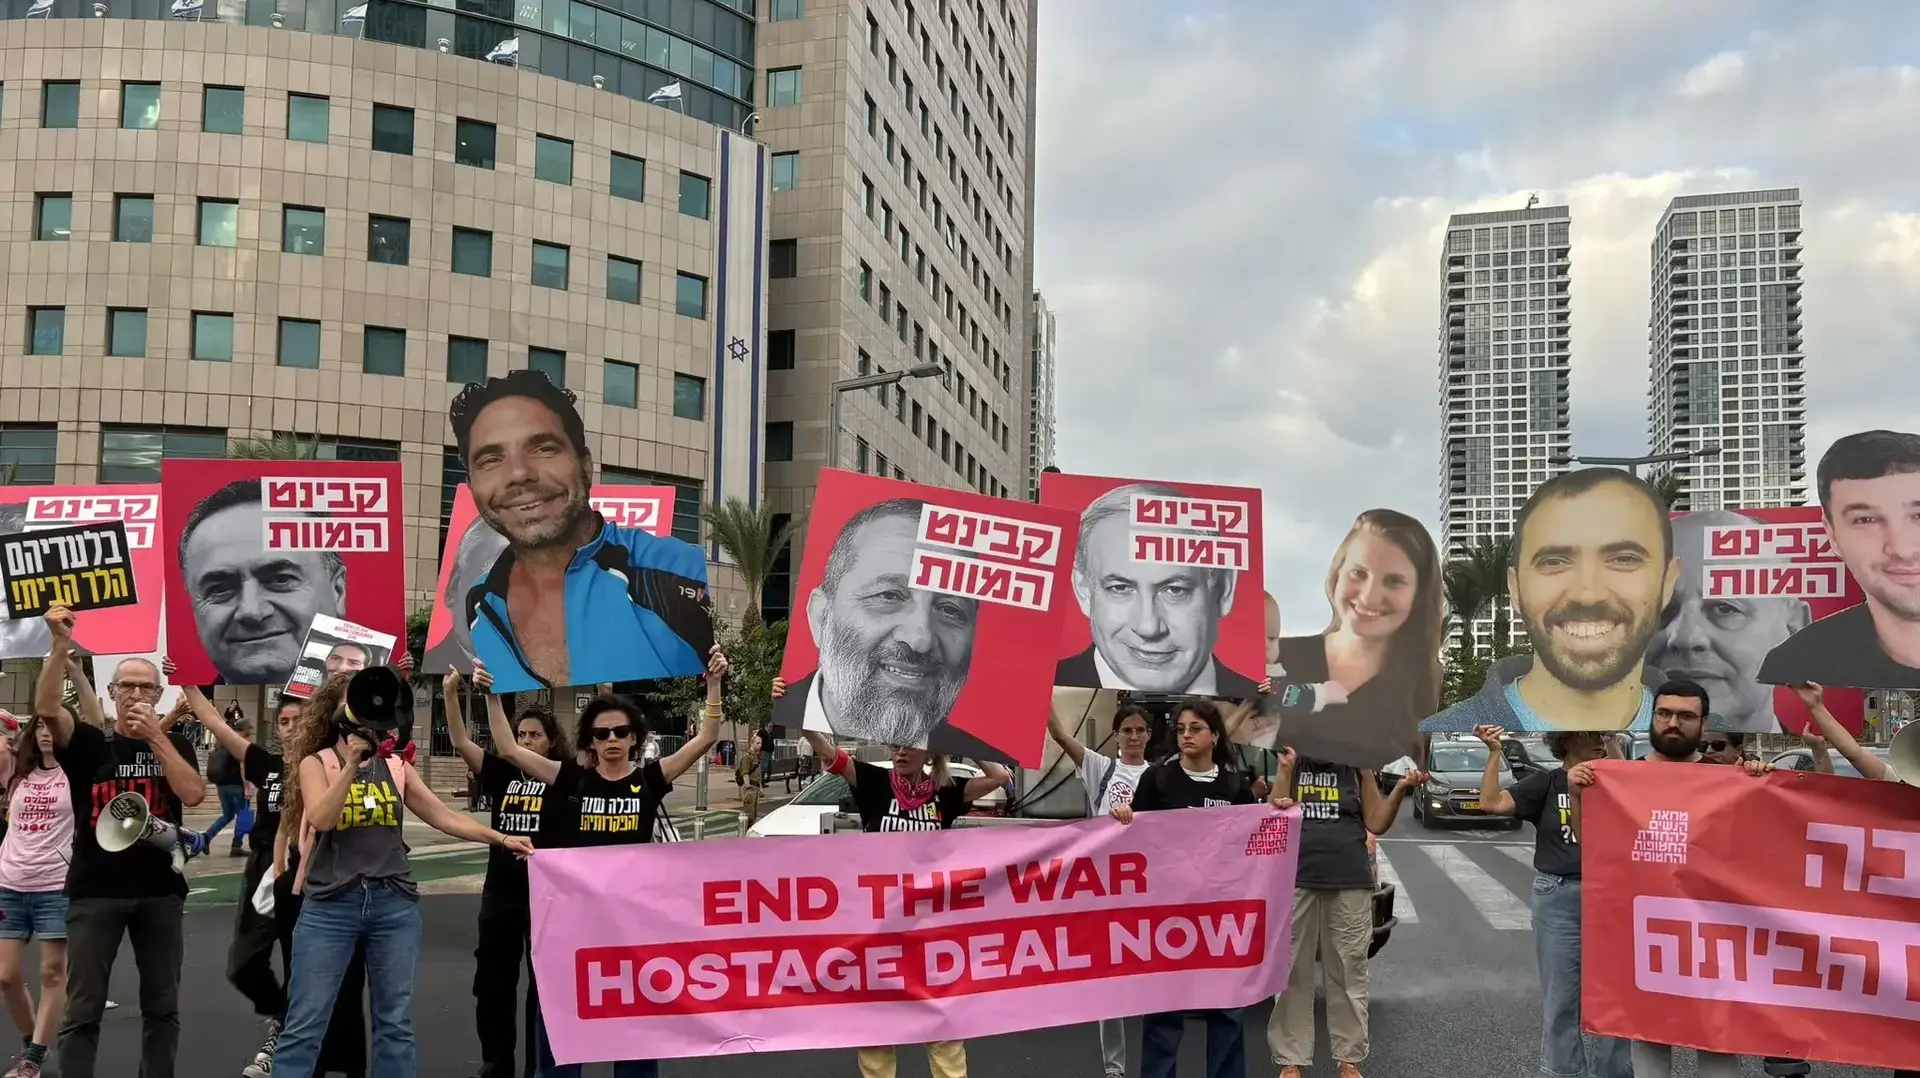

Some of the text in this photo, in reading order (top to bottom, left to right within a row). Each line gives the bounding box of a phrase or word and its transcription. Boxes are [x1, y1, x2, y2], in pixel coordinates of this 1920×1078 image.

[269, 482, 381, 512] קבינט
[34, 498, 152, 523] קבינט
[592, 502, 653, 528] קבי
[1136, 498, 1242, 536] קבינט
[268, 522, 382, 548] המוות
[926, 510, 1054, 560] קבינט
[1711, 526, 1831, 561] קבינט
[5, 530, 123, 577] בלעדיהם
[1135, 535, 1242, 567] המוות
[10, 567, 129, 611] הלך הבית!
[916, 555, 1045, 606] המוות
[1709, 567, 1837, 596] המוות
[296, 665, 321, 678] BRING
[289, 682, 313, 693] HOME
[521, 780, 546, 796] למה
[1299, 771, 1338, 787] למה הם
[24, 796, 58, 804] שכולם
[344, 781, 397, 804] EAL
[500, 795, 543, 812] עדיין
[1297, 785, 1340, 801] עדיין
[581, 796, 640, 814] תכלה שנה
[1651, 809, 1688, 821] מחאת
[337, 804, 398, 831] DEAL
[500, 812, 540, 832] בעזה?
[1260, 824, 1288, 833] הנשים
[1261, 816, 1289, 825] מחאת
[1649, 820, 1688, 832] הנשים
[1634, 839, 1687, 854] החטופות
[1637, 829, 1687, 842] להחזרת
[1631, 850, 1687, 864] והחטופים
[703, 852, 1147, 926] END THE WAR
[588, 912, 1257, 1006] HOSTAGE DEAL NOW
[1646, 917, 1881, 996] הביתה
